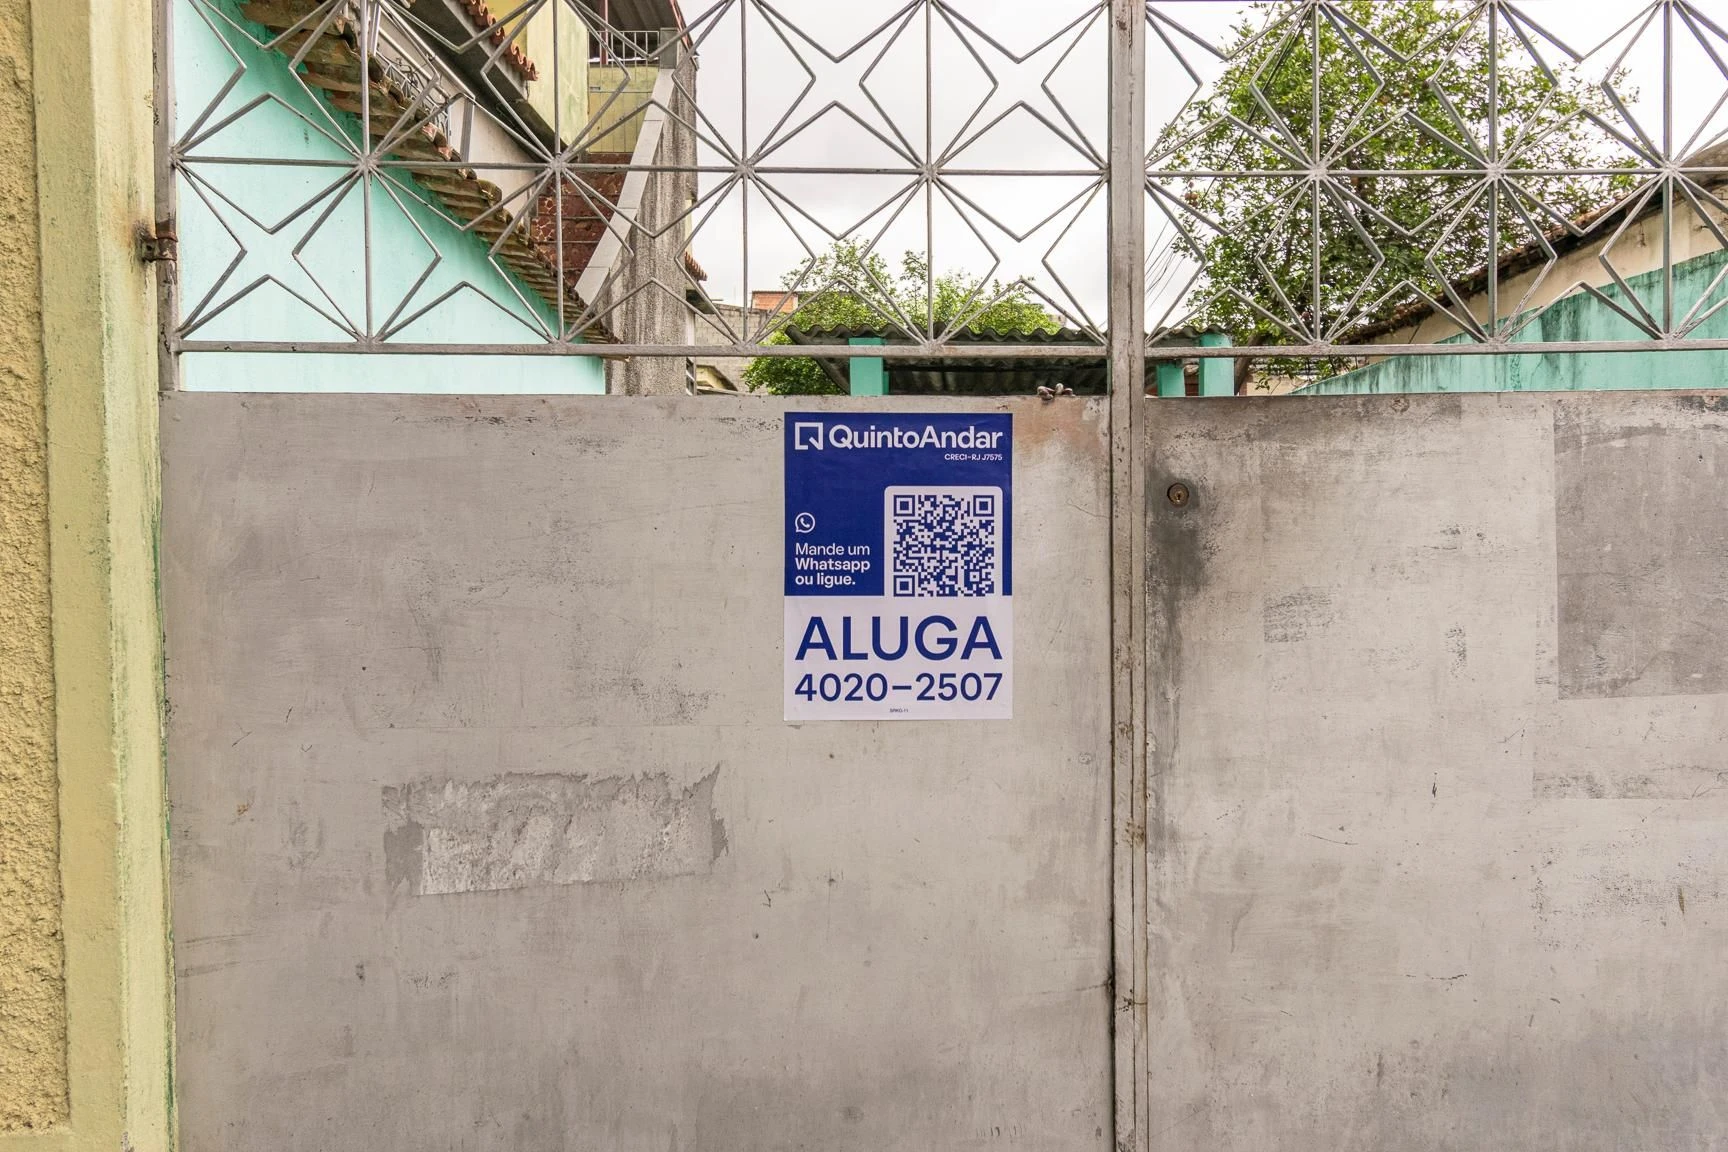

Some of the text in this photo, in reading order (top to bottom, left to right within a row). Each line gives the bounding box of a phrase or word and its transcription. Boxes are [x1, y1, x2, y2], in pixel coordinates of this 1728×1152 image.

[828, 424, 1003, 450] QuintoAndar
[944, 453, 981, 461] CRECI-RJ
[795, 542, 870, 556] Mande um
[795, 557, 871, 573] Whatsapp
[795, 572, 856, 589] ou ligue.
[795, 615, 1003, 661] ALUGA
[794, 672, 1003, 702] 4020-2507
